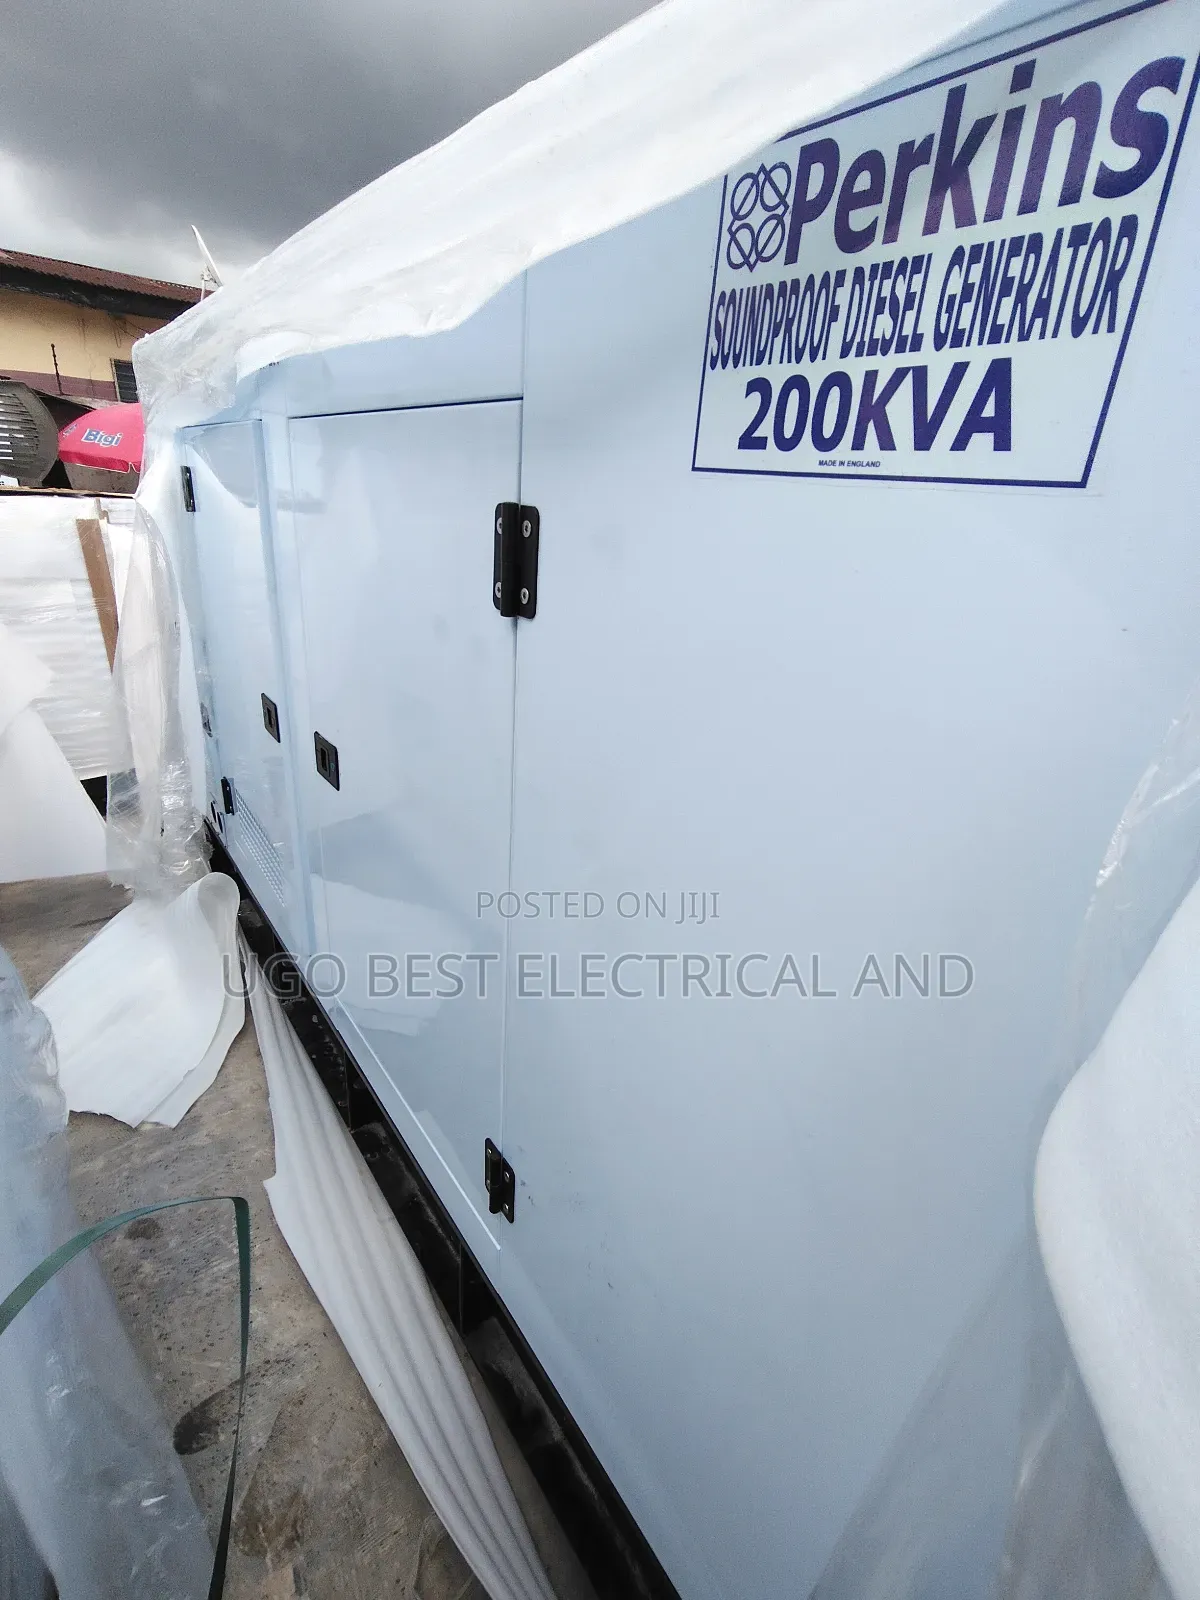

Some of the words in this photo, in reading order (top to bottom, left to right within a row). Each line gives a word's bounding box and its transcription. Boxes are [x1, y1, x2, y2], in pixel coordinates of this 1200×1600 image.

[784, 56, 1186, 266] Perkins
[709, 269, 847, 371] SOUNDPROOF
[839, 252, 933, 360] DIESEL
[933, 214, 1139, 352] GENERATOR
[81, 428, 123, 447] Bigi
[737, 357, 1013, 453] 200KVA
